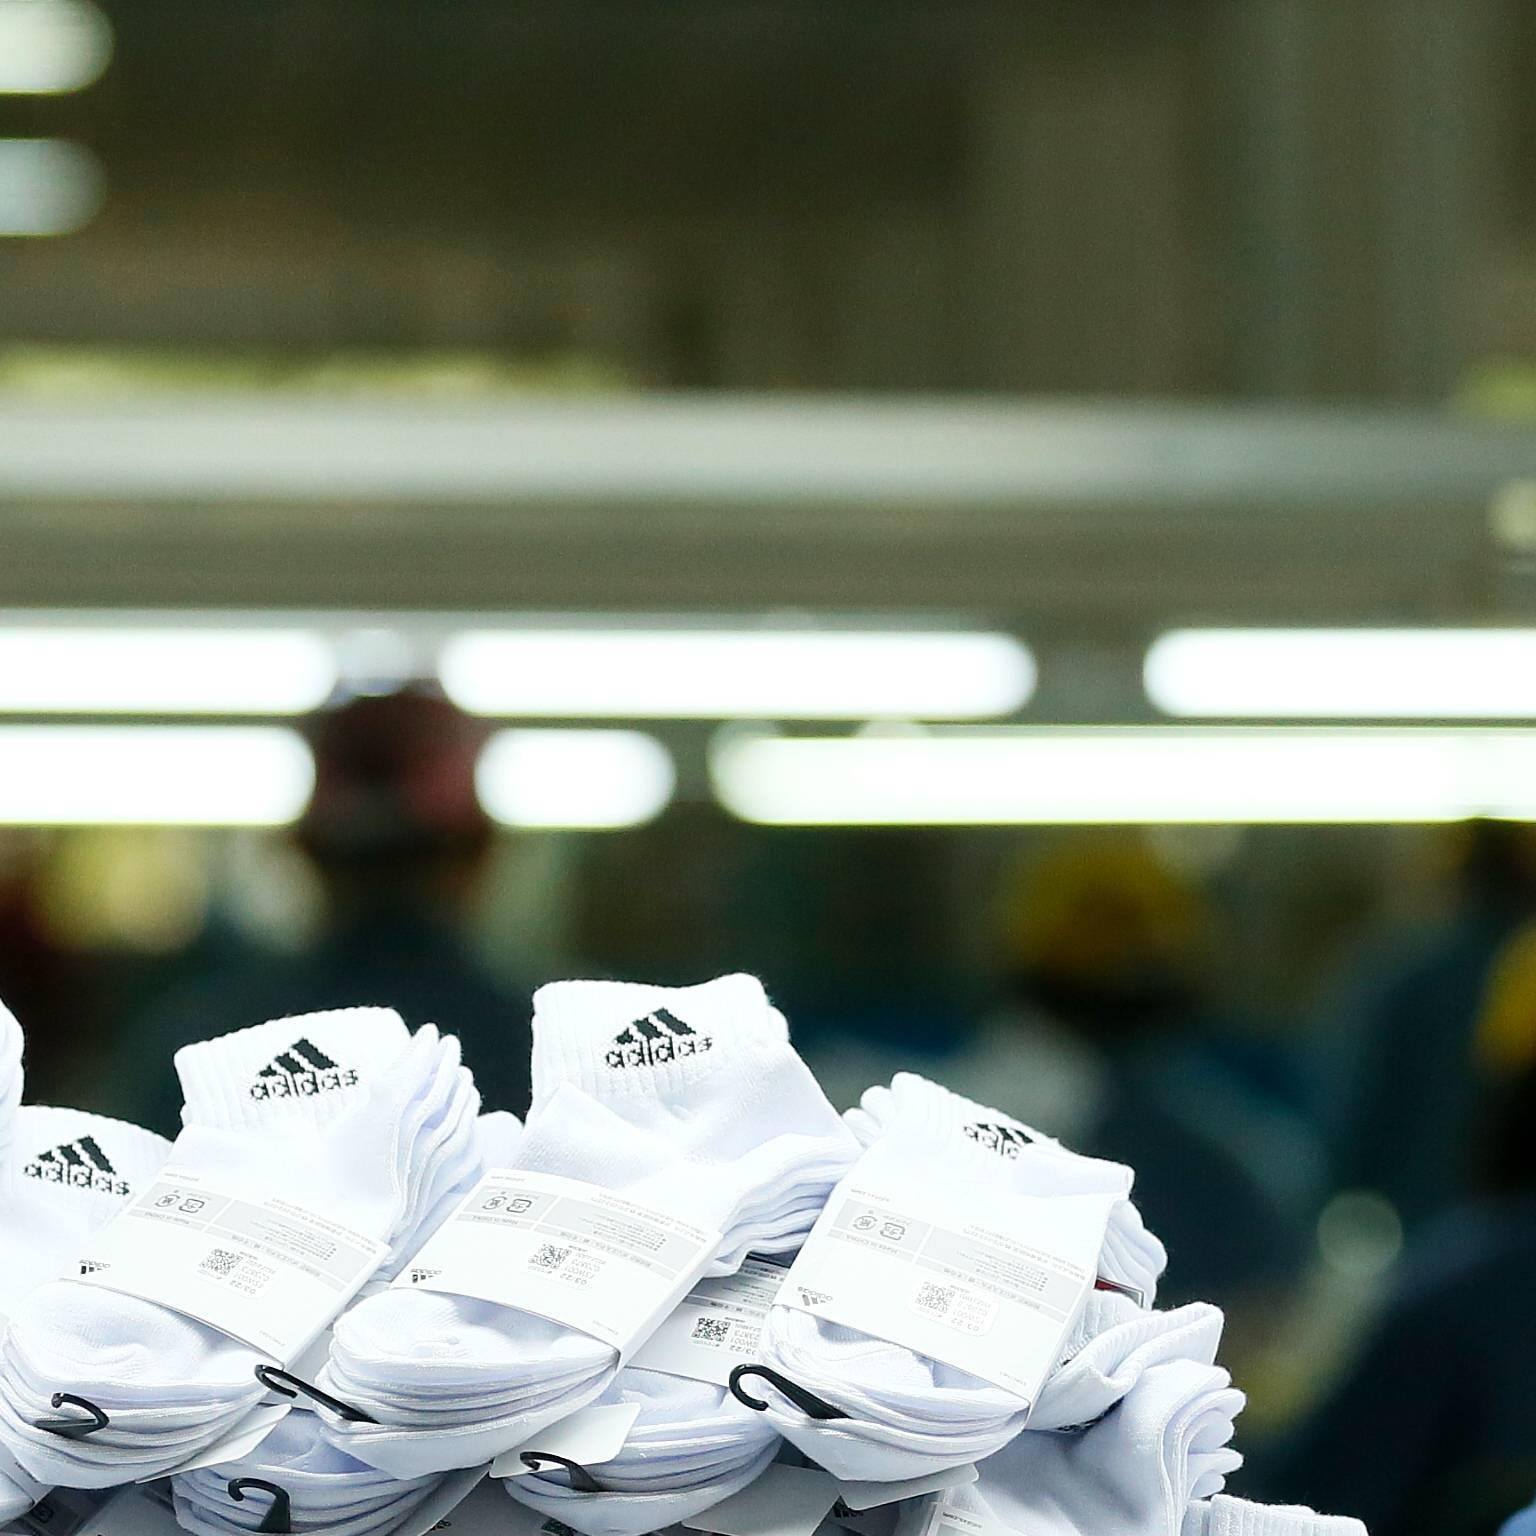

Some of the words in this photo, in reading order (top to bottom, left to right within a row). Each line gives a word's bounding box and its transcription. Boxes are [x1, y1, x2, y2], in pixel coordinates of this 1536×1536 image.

[605, 1035, 713, 1071] adidas
[250, 1069, 360, 1101] adidas
[24, 1158, 130, 1198] adidas
